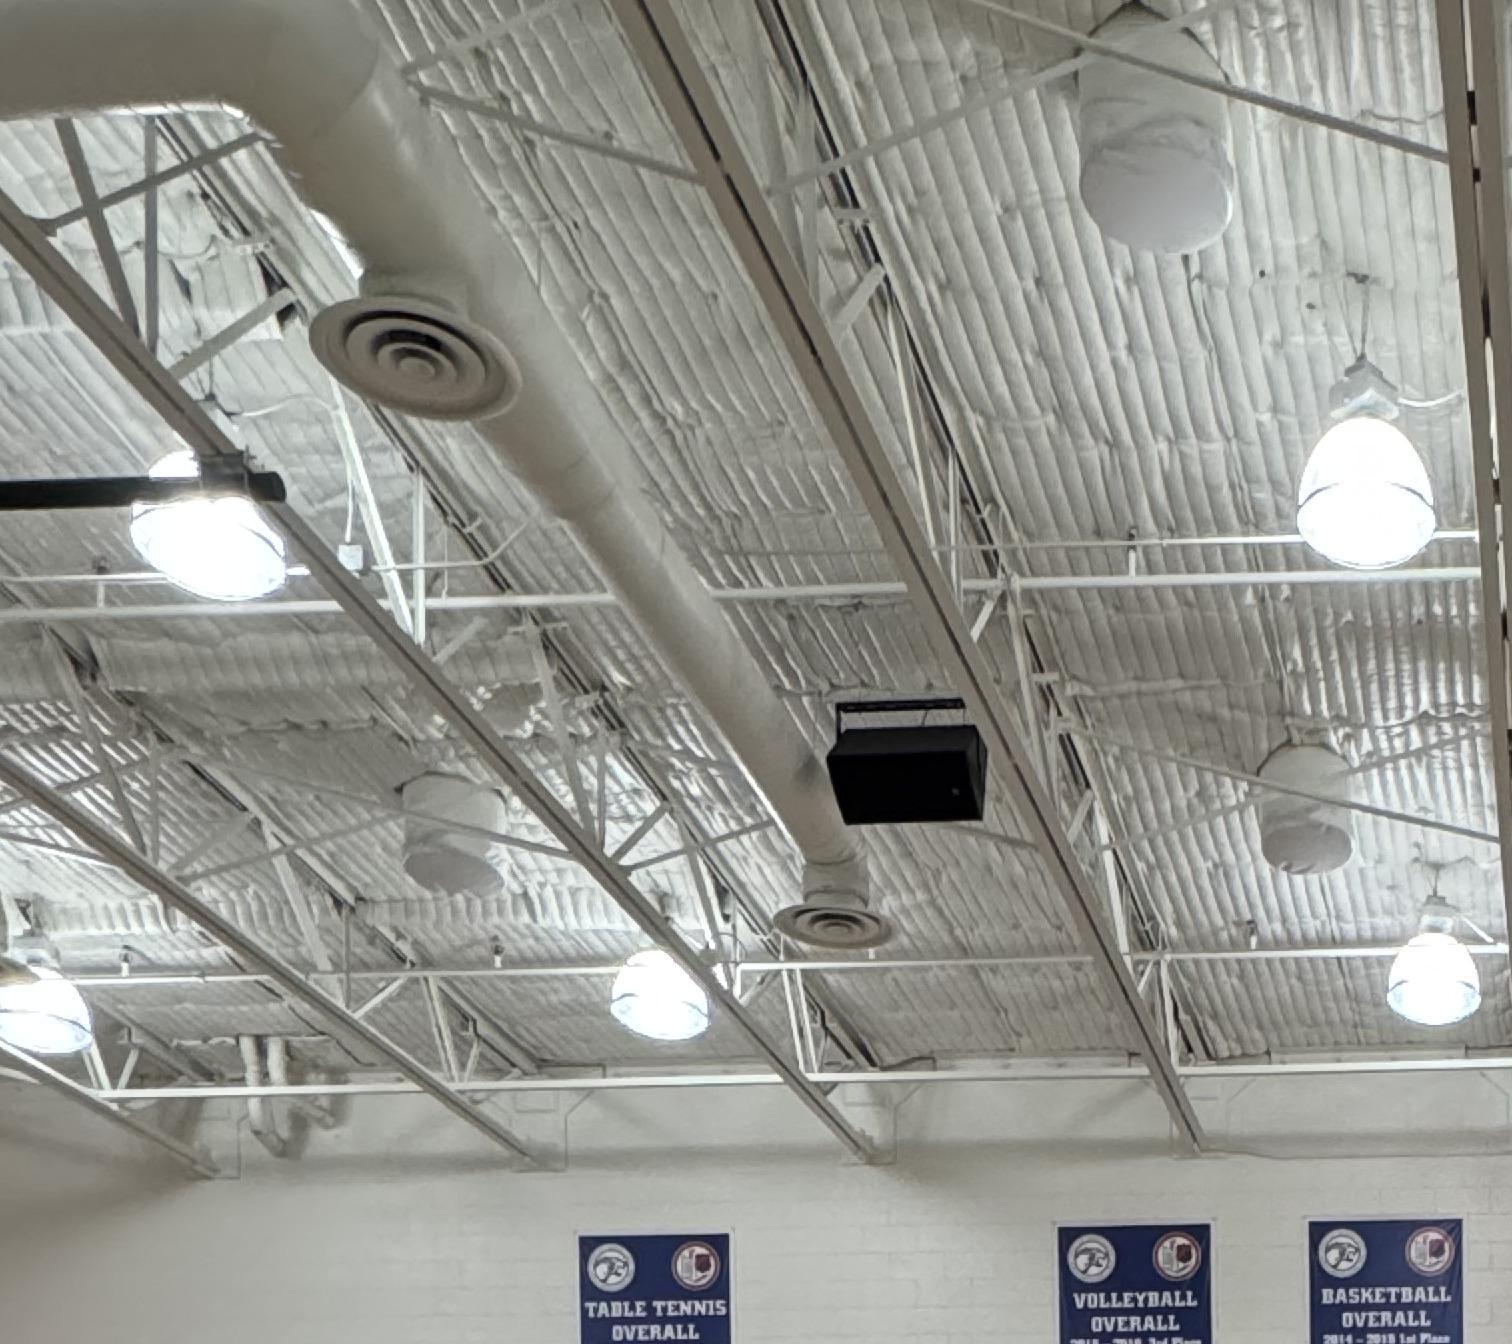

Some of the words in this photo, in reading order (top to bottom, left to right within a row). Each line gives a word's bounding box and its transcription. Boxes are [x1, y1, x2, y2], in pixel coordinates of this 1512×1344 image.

[1073, 1292, 1197, 1307] VOLLEYBALL
[1322, 1287, 1451, 1303] BASKETBALL
[585, 1301, 647, 1317] TABLE
[653, 1300, 727, 1317] TENNIS
[1091, 1316, 1179, 1331] OVERALL
[1343, 1311, 1431, 1327] OVERALL
[613, 1325, 699, 1340] OVERALL
